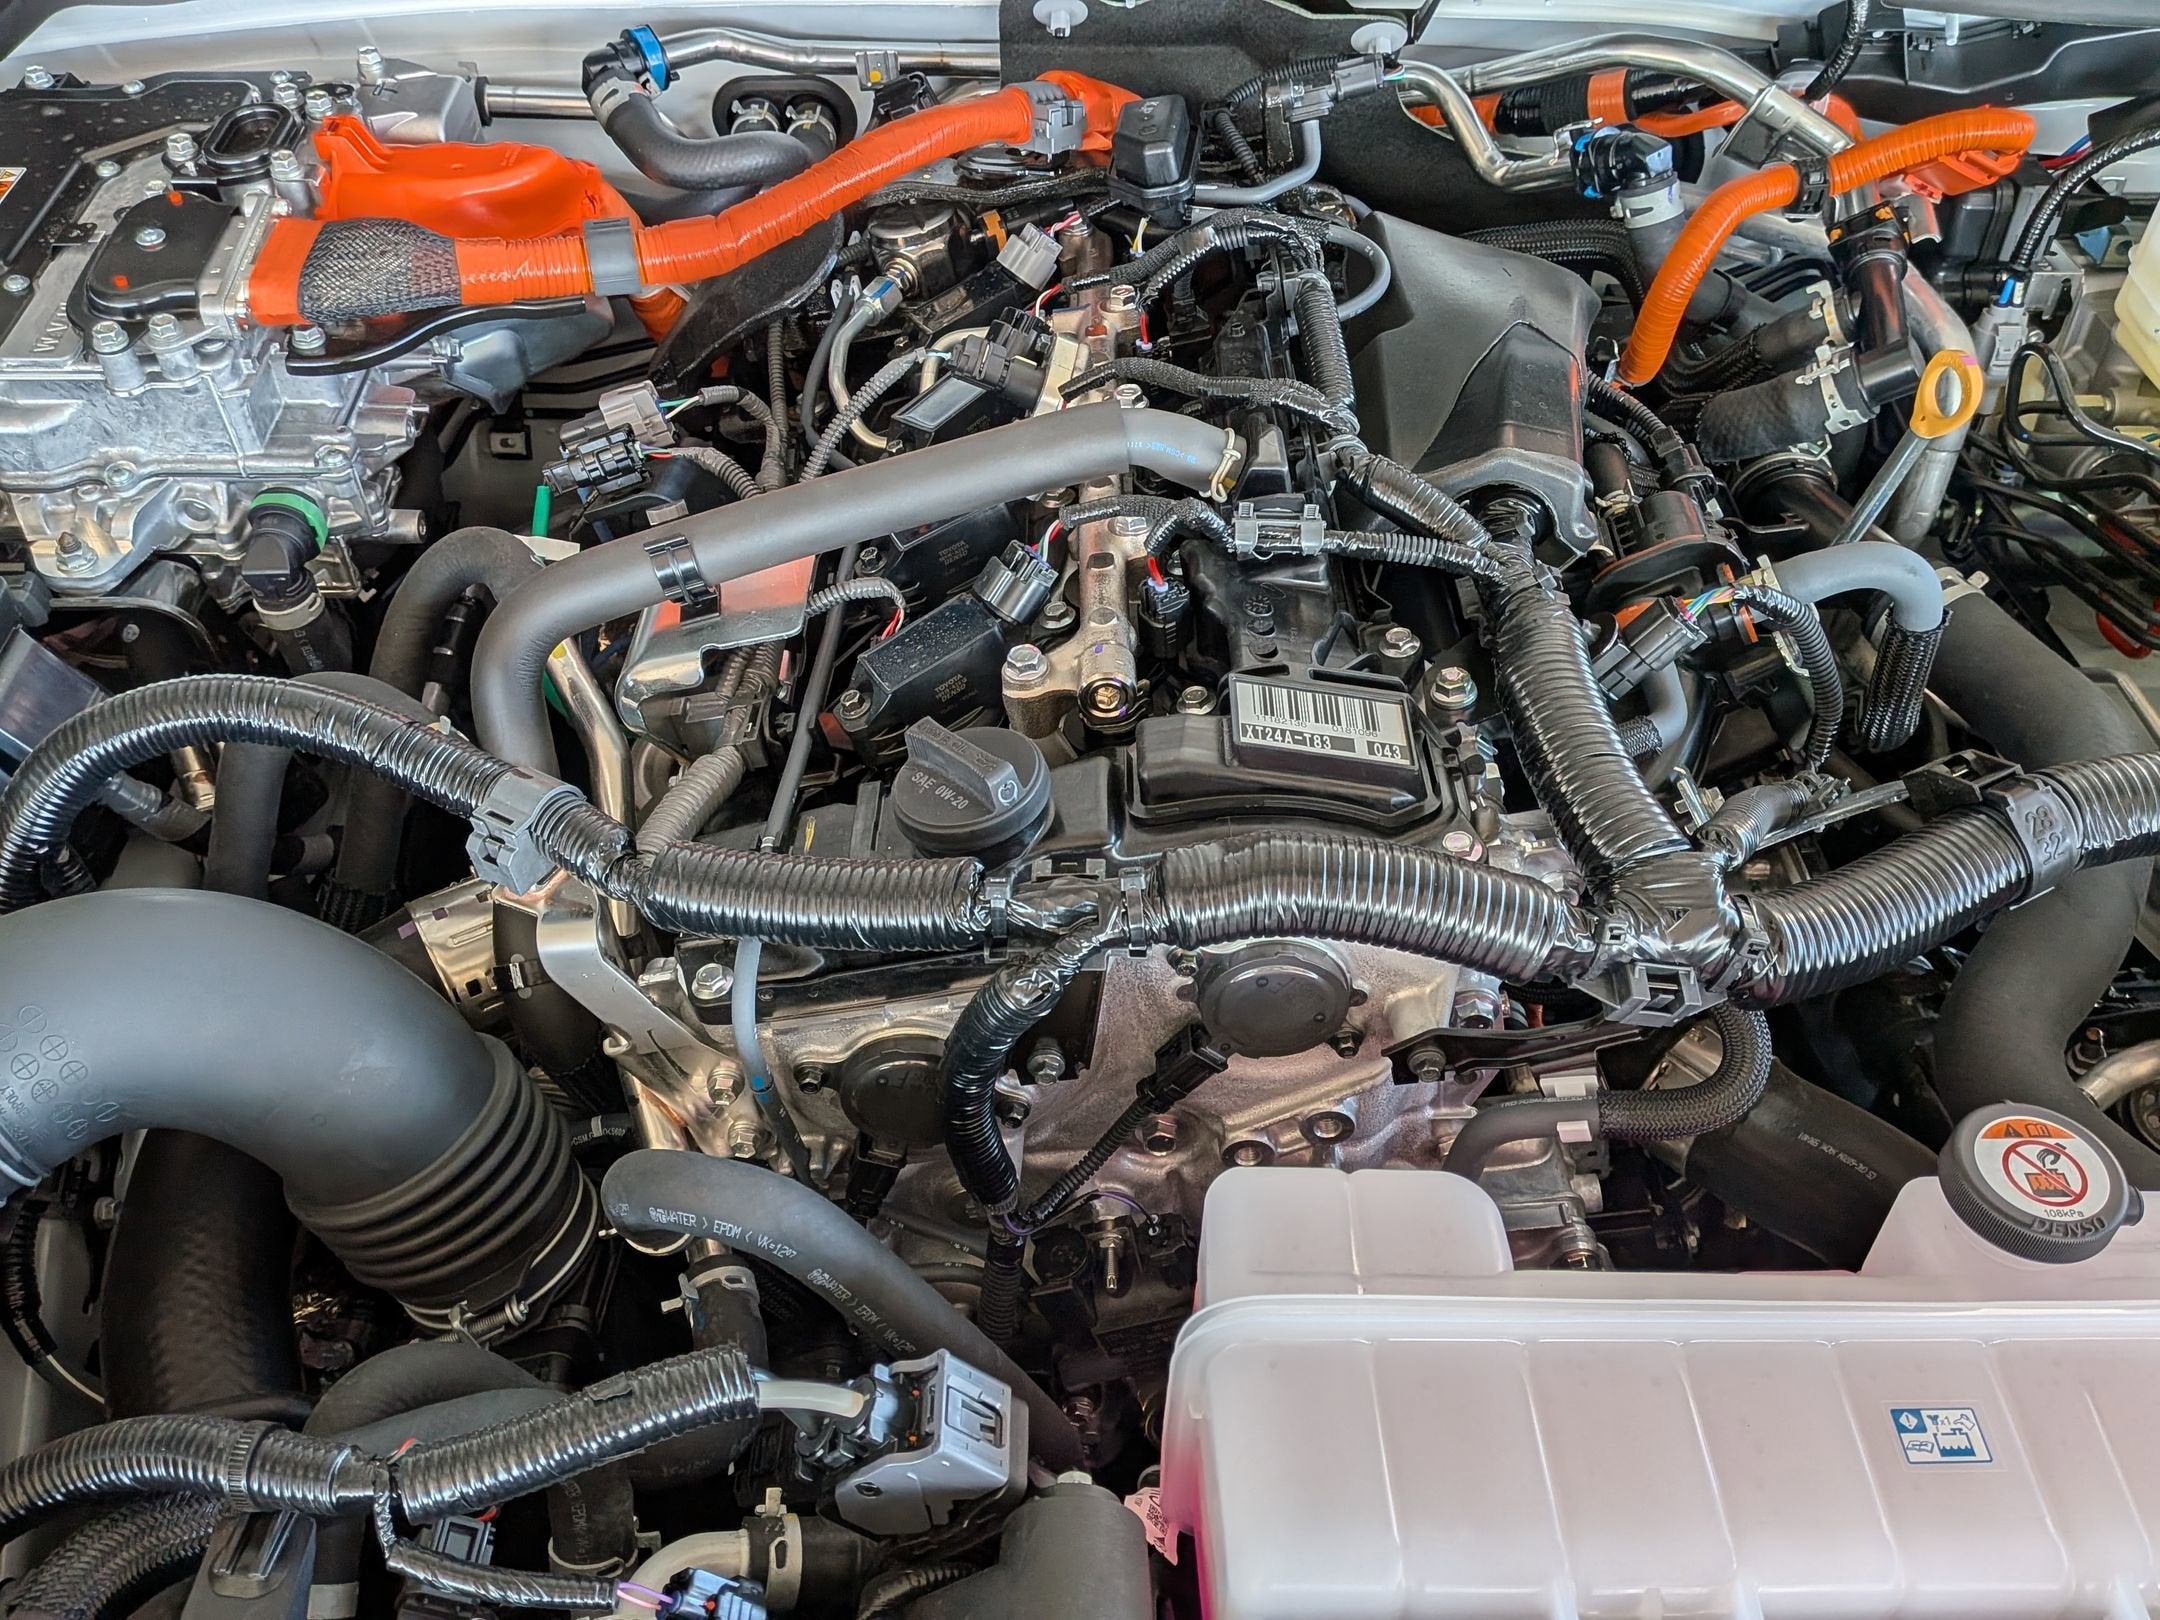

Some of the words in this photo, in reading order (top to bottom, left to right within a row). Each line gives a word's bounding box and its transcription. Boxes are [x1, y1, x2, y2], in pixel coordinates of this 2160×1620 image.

[934, 674, 963, 692] TOYOTA
[1245, 725, 1332, 750] XT24A-T83
[1374, 743, 1402, 760] 043
[911, 771, 937, 789] SAE
[935, 784, 969, 810] 0W-20
[2025, 805, 2053, 838] 28
[2037, 832, 2064, 866] 32
[2044, 1208, 2085, 1218] 108kPa
[713, 1220, 743, 1239] EPDM
[2031, 1216, 2107, 1238] DENSO
[854, 1304, 880, 1324] EPDM
[1940, 1416, 1951, 1426] x1
